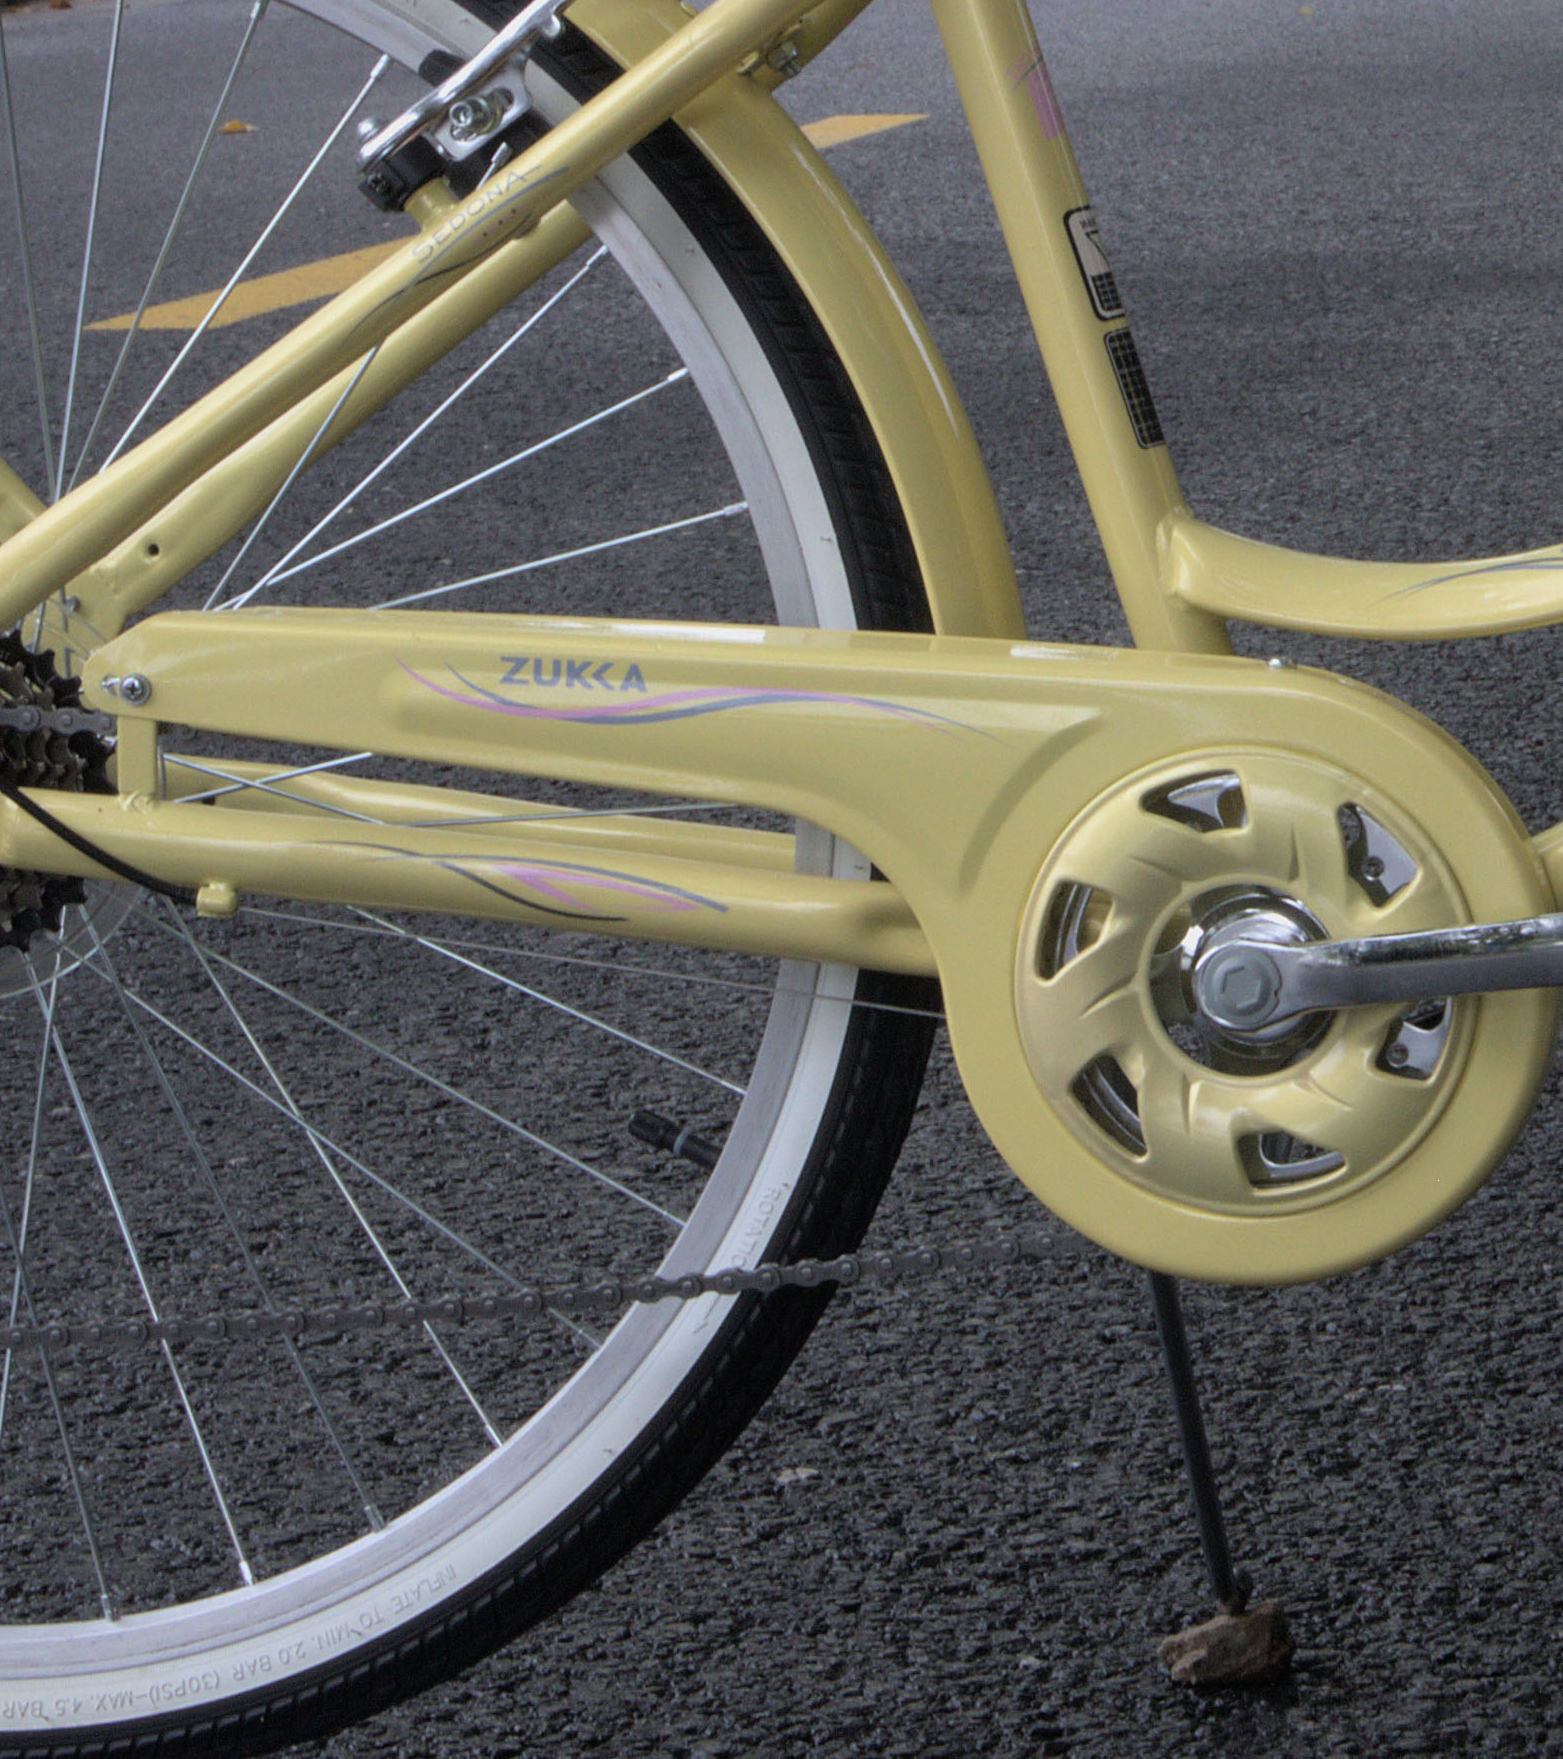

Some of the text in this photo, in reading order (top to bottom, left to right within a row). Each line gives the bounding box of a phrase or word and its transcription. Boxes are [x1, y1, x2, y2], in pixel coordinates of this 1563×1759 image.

[412, 165, 541, 264] SEDONA
[500, 655, 648, 692] ZUKKA
[392, 1564, 457, 1614] INFLATE
[356, 1604, 385, 1631] TO
[309, 1619, 353, 1653] MIN.
[229, 1652, 274, 1683] BAR
[276, 1639, 308, 1667] 2.0
[2, 1698, 44, 1720] BAR
[54, 1696, 83, 1717] 4.5
